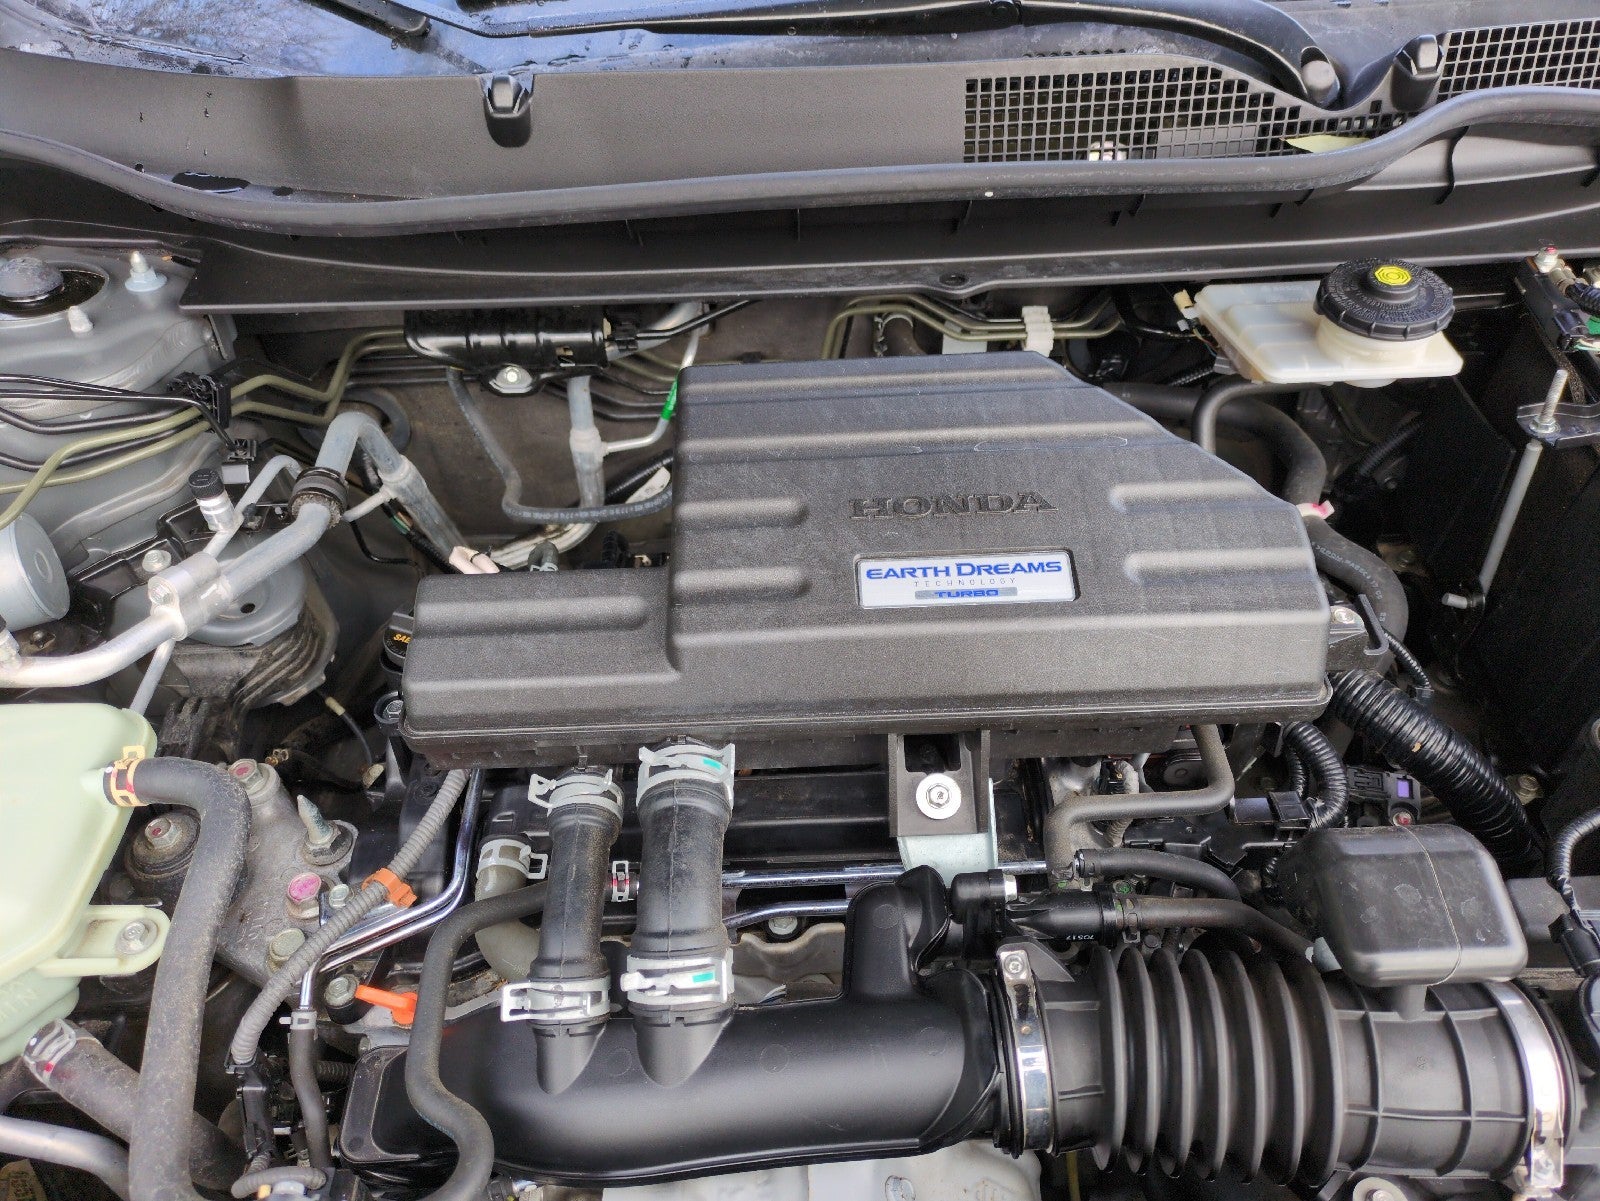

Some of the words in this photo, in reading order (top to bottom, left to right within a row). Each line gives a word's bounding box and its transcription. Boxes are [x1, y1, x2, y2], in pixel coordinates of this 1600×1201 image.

[850, 491, 1059, 519] HONDA
[866, 565, 950, 579] EARTH
[955, 561, 1062, 577] DREAMS
[914, 577, 1016, 587] TECHNOLOGY
[935, 589, 999, 598] TURBO
